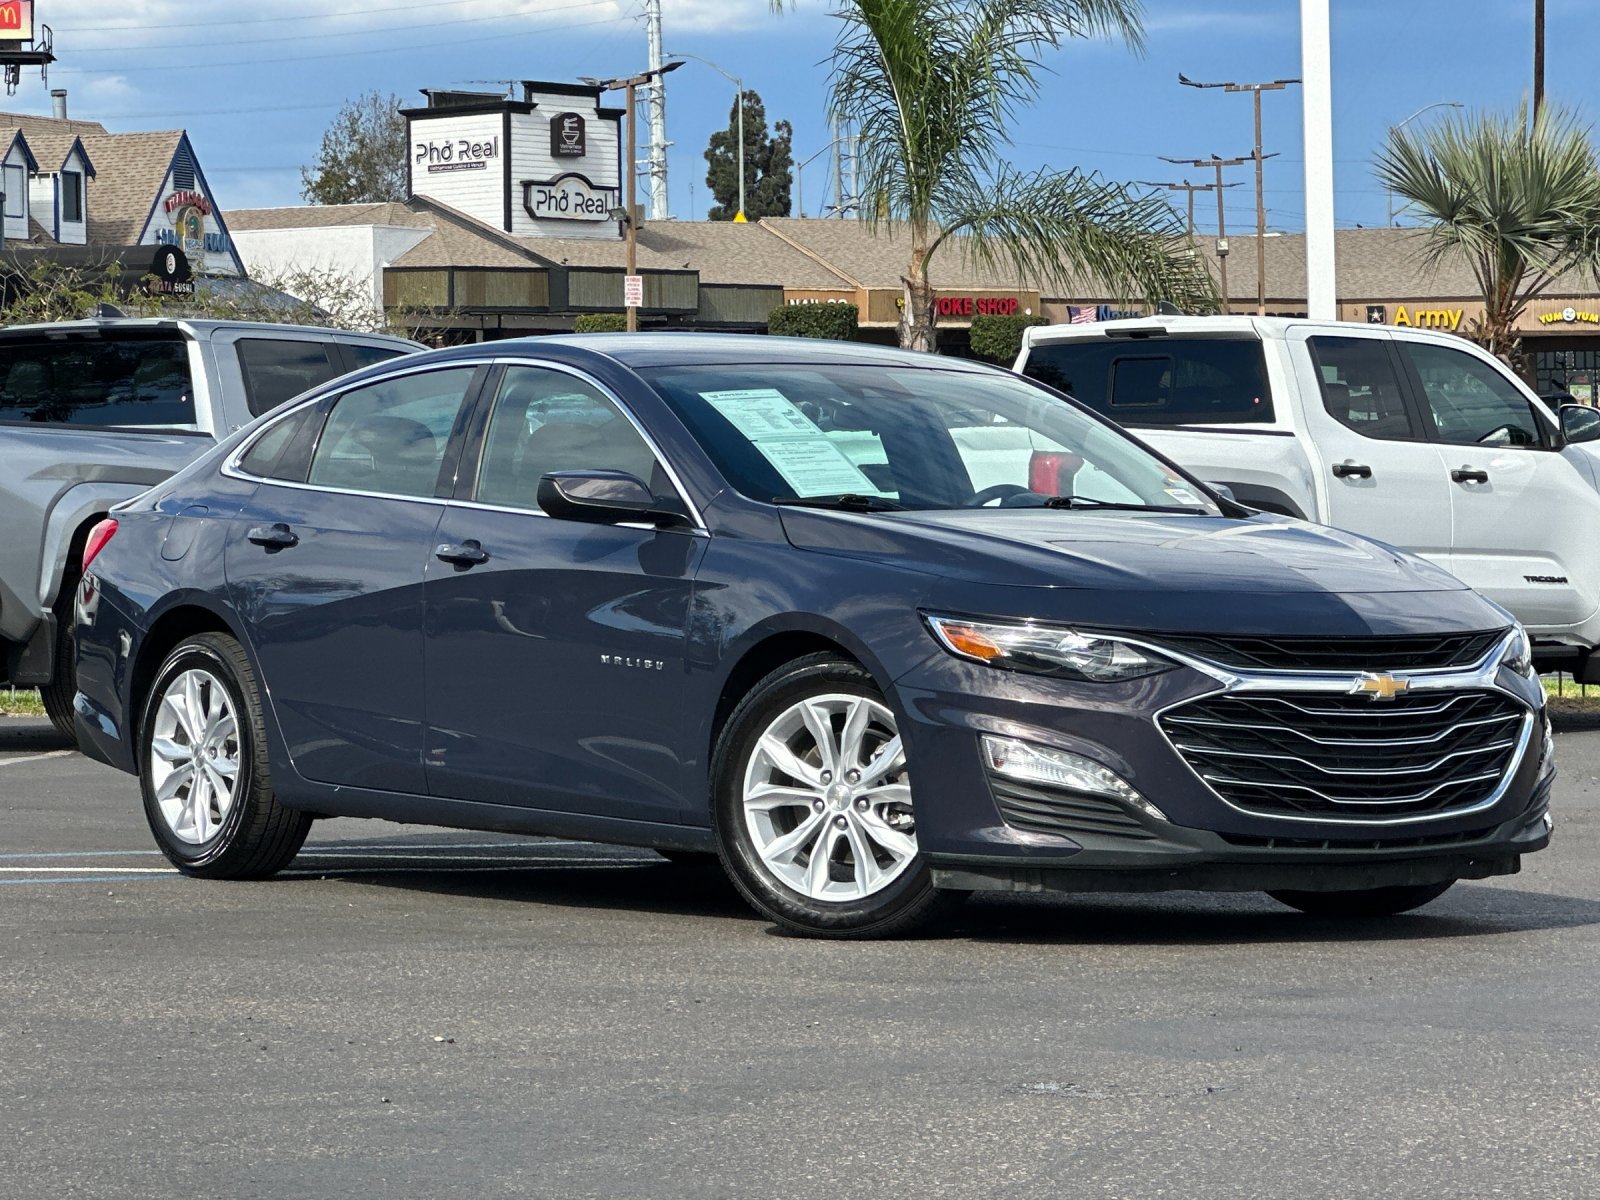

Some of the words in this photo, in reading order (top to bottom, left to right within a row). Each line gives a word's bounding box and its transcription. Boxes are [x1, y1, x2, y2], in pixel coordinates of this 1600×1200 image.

[458, 136, 498, 160] Real
[574, 192, 608, 214] Real
[174, 282, 193, 293] SUSHI
[935, 297, 974, 315] OKE
[976, 297, 1019, 316] SHOP
[1393, 305, 1463, 331] Army
[1539, 311, 1563, 324] YUM
[1576, 311, 1599, 323] YUM
[600, 654, 664, 671] MALIBU
